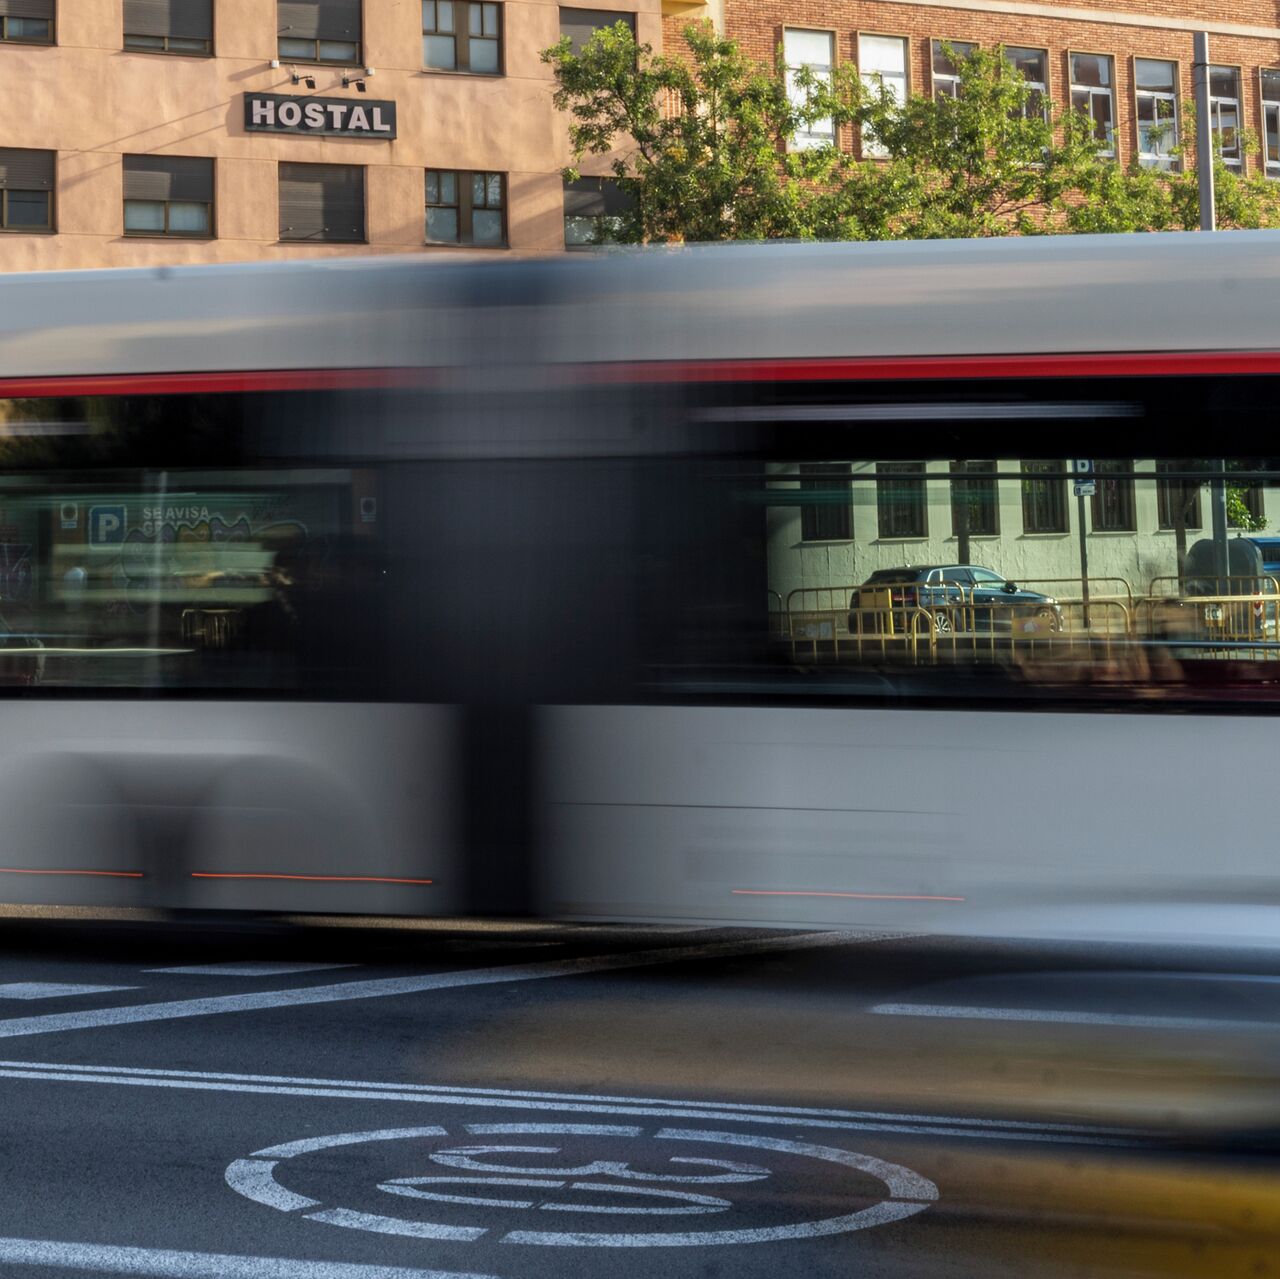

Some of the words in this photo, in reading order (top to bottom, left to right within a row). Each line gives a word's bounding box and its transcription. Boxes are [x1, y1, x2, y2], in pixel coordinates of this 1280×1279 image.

[252, 99, 391, 132] HOSTAL
[143, 506, 162, 520] SE
[165, 505, 209, 520] AVISA
[98, 513, 120, 542] P
